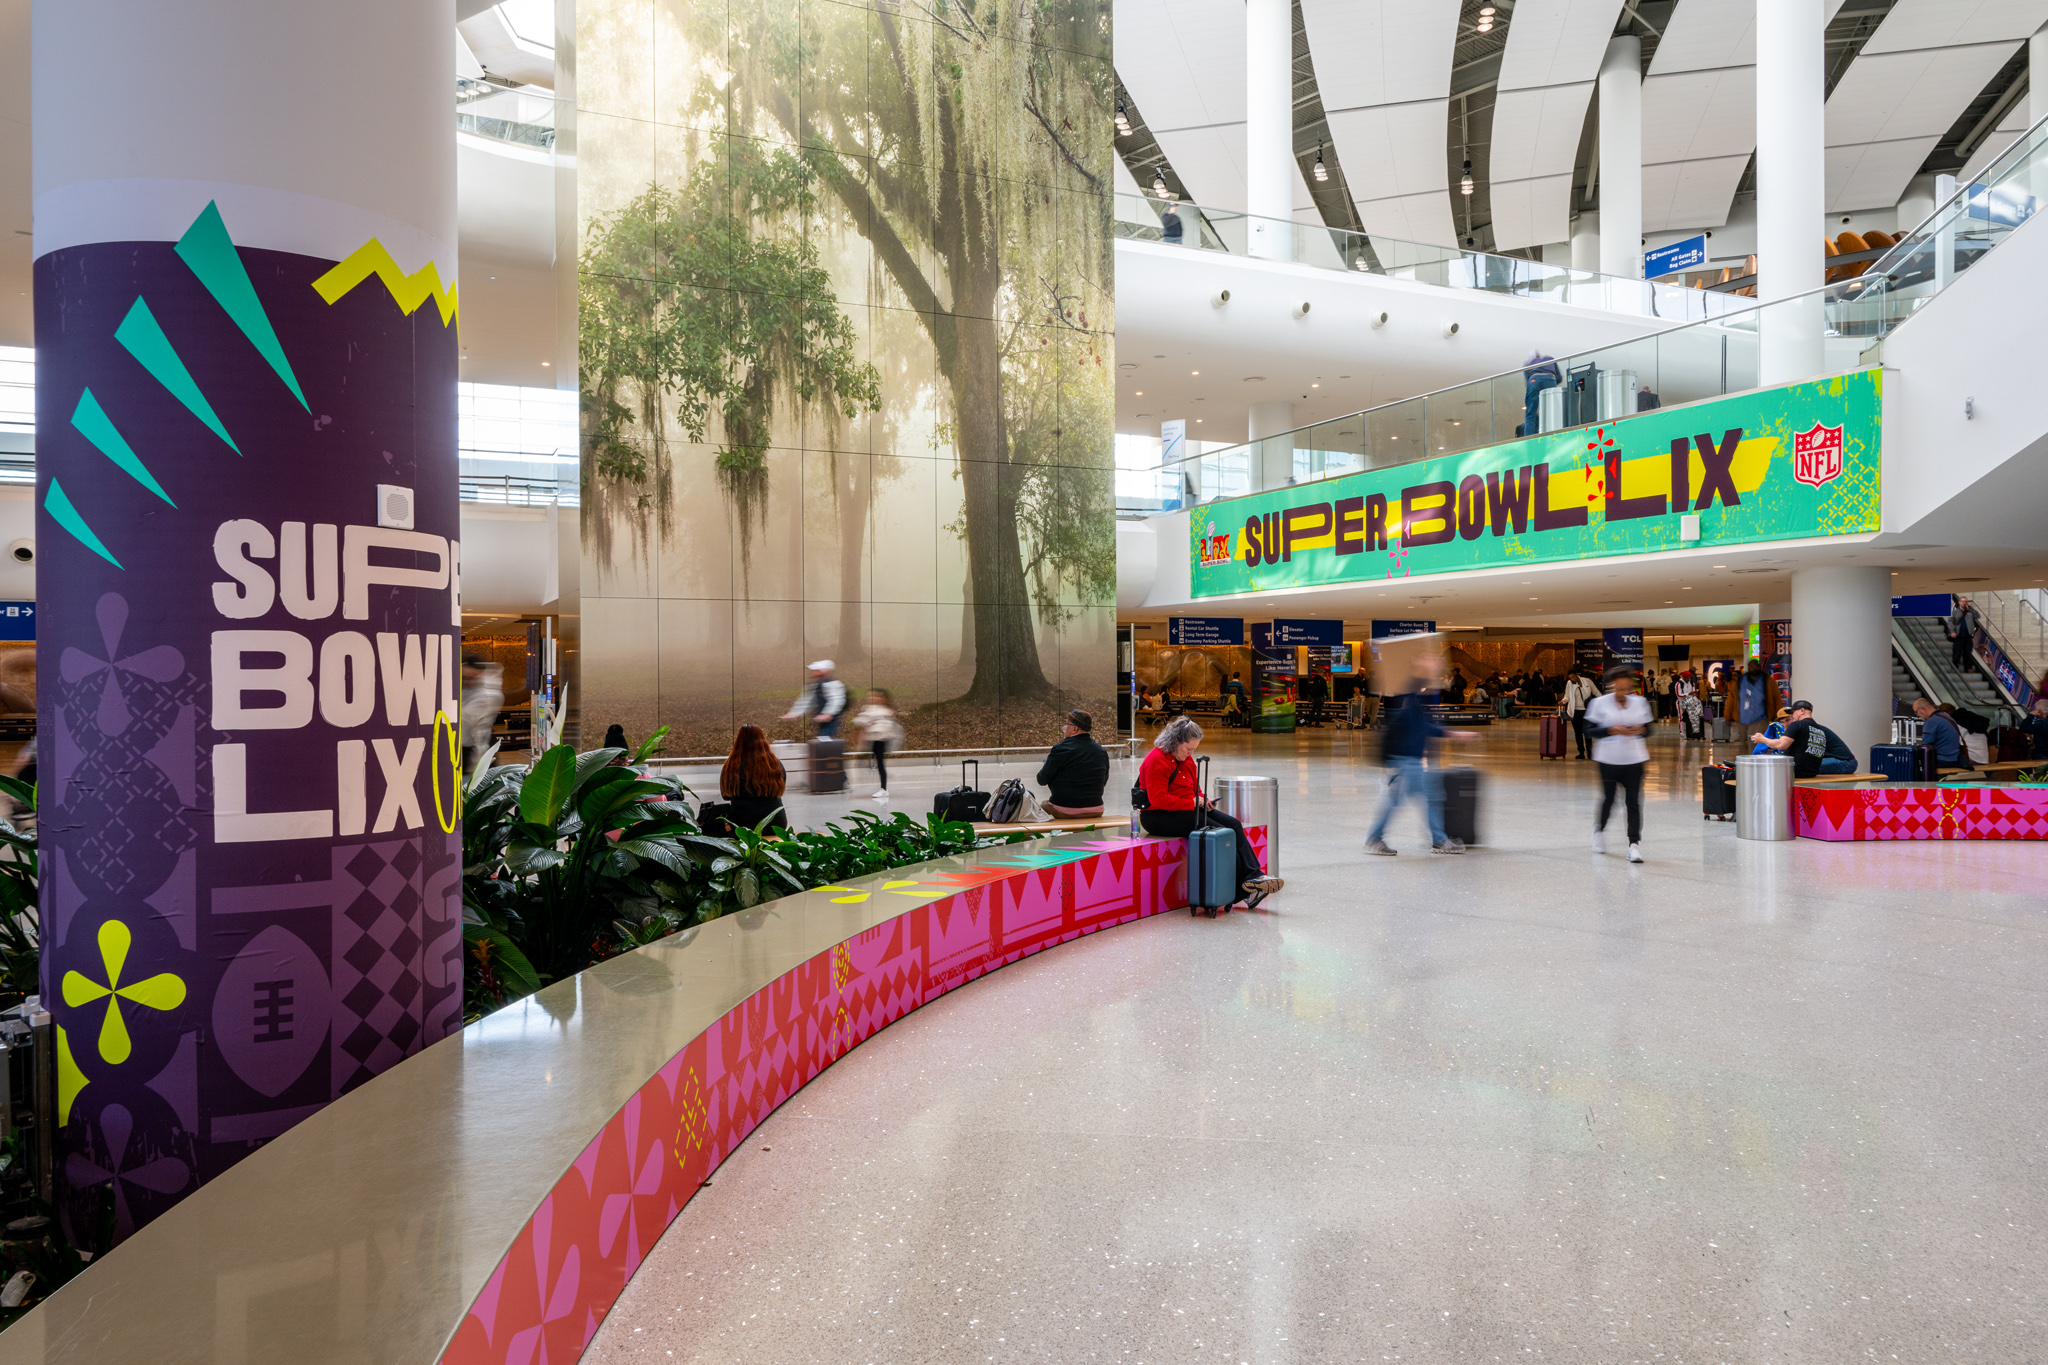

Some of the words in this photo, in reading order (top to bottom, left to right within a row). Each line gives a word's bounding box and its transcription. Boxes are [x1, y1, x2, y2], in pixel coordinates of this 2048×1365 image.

[1657, 248, 1680, 257] Restrooms
[1678, 252, 1691, 260] Gates
[1799, 449, 1837, 480] NFL
[1245, 493, 1388, 567] SUPER
[1401, 462, 1588, 549] BOWL
[1605, 428, 1743, 522] LIX
[210, 630, 458, 731] BOWL
[1708, 662, 1723, 689] 6
[212, 737, 426, 843] LIX
